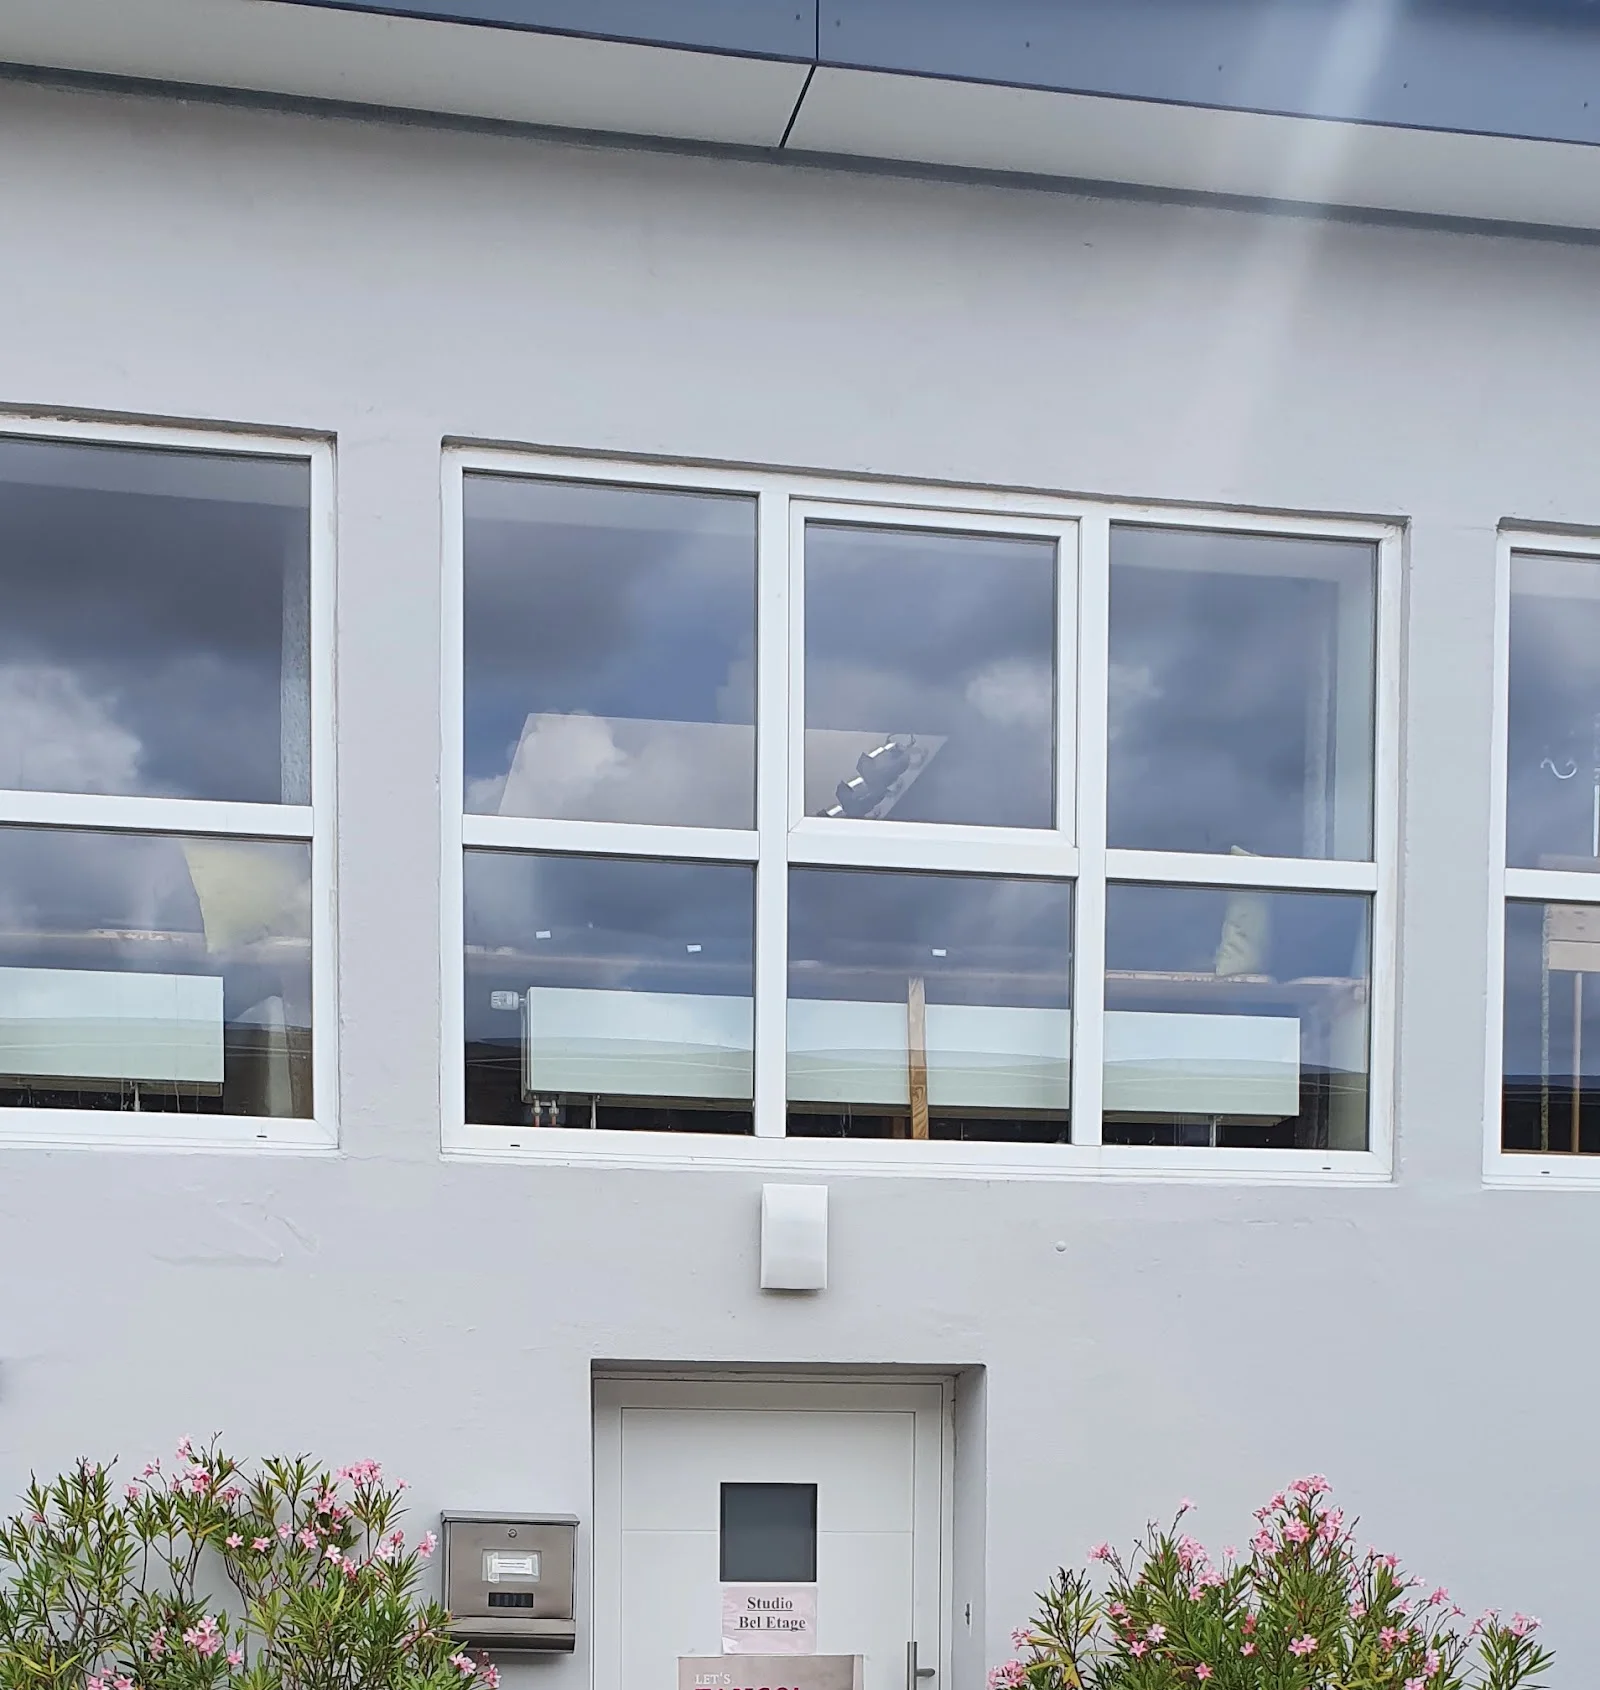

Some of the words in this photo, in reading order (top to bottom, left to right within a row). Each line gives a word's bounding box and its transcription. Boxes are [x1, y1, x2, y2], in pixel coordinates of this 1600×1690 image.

[747, 1596, 793, 1610] Studio
[739, 1616, 761, 1629] Bel
[766, 1616, 806, 1632] Etage
[695, 1672, 731, 1685] LET'S
